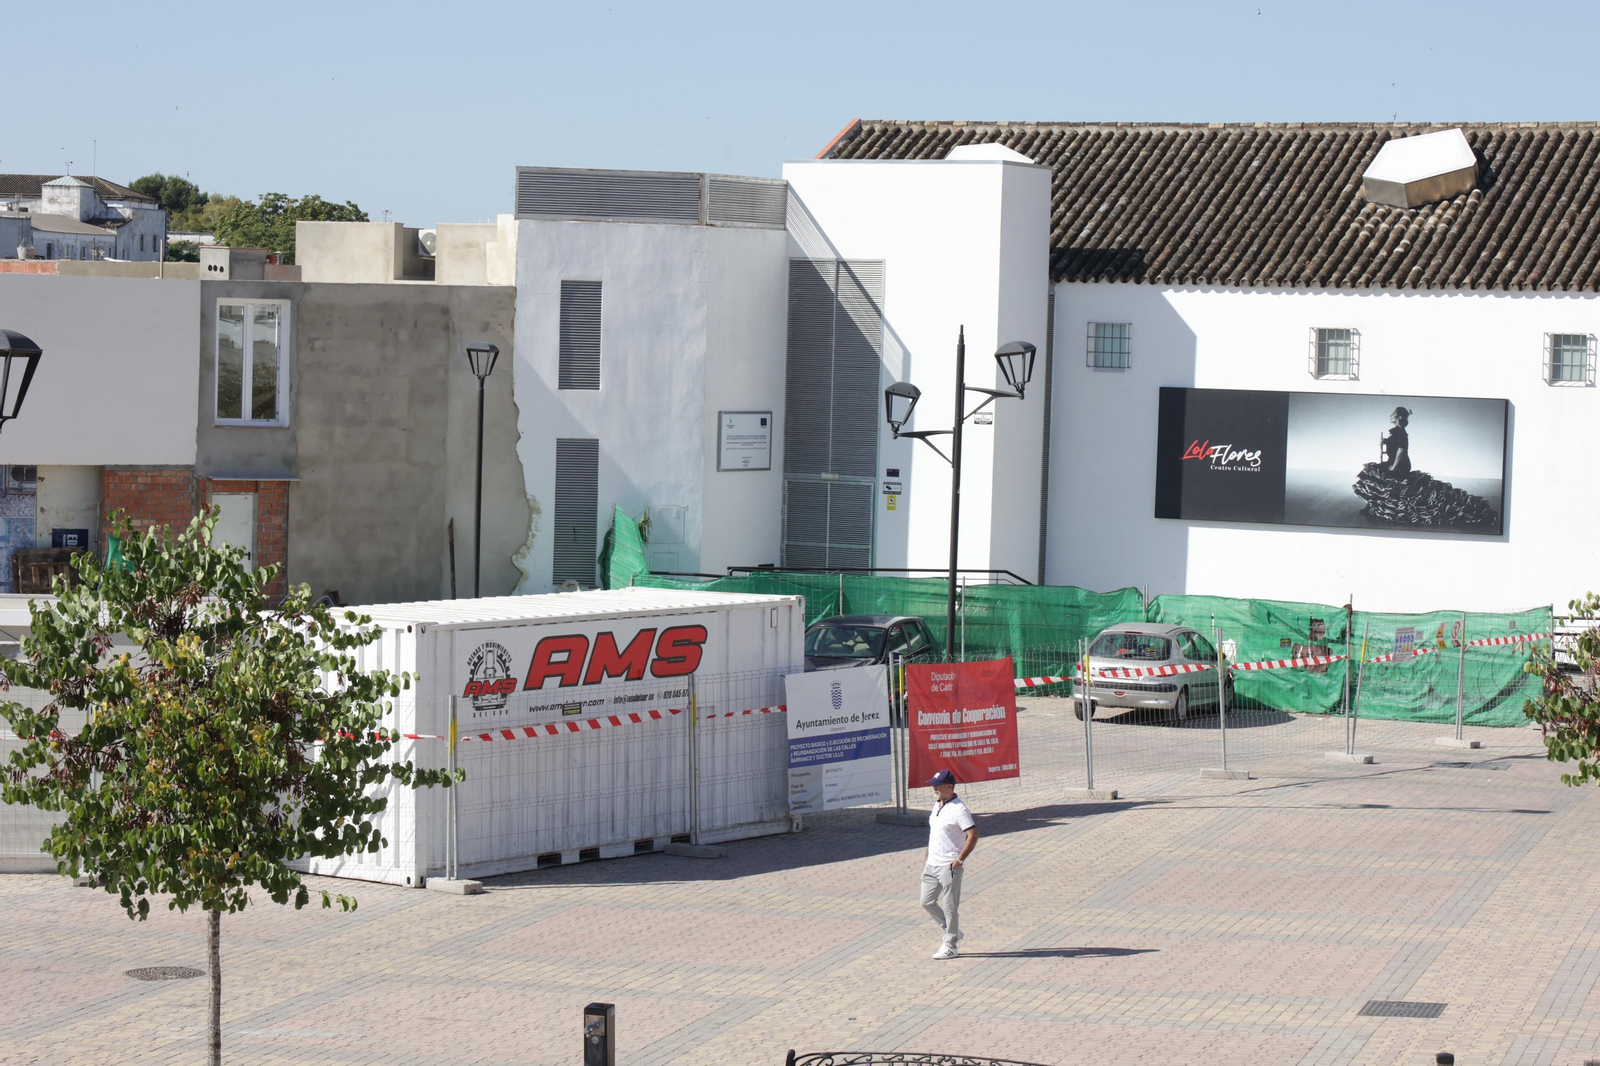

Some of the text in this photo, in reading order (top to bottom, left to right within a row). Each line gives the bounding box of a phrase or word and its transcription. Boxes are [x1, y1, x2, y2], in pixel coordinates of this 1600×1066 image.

[1179, 440, 1262, 467] Lola Flores
[523, 624, 708, 691] AMS
[930, 671, 956, 682] Diputació
[462, 678, 517, 698] AMS
[930, 683, 939, 692] de
[796, 711, 880, 731] Ayuntamiento de Jerez
[952, 709, 961, 724] de
[962, 705, 1006, 724] Cooperación
